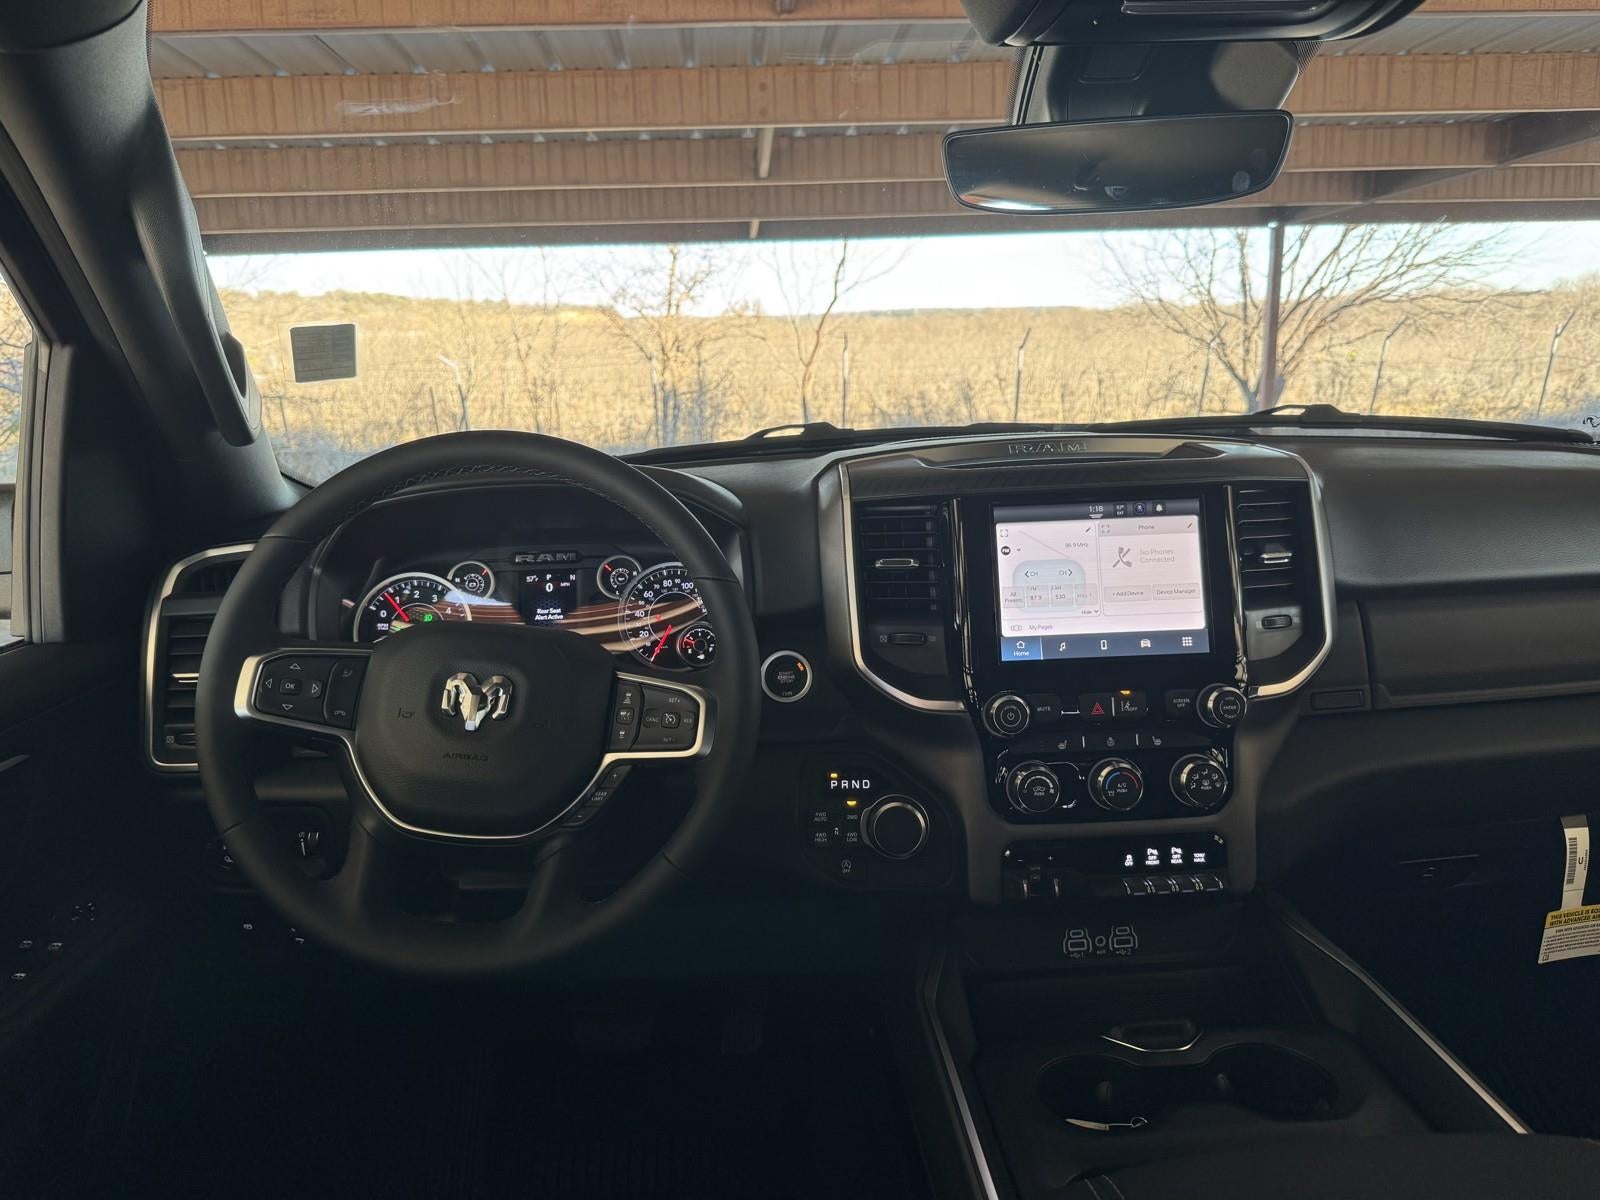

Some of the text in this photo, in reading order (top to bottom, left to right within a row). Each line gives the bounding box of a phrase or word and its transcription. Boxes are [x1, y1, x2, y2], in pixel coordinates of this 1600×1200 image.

[1008, 440, 1088, 455] RAM
[1088, 505, 1104, 513] 1:18
[1140, 547, 1174, 556] No Phones
[515, 552, 577, 562] RAM
[545, 582, 553, 592] 0
[663, 579, 673, 587] 80
[681, 582, 694, 590] 100
[414, 591, 420, 599] 2
[644, 590, 654, 598] 60
[380, 610, 387, 618] 0
[634, 610, 645, 618] 40
[1038, 624, 1053, 632] Pages
[639, 630, 649, 638] 20
[443, 752, 488, 762] AIRBAG
[1563, 909, 1585, 919] VEHICLE
[1563, 915, 1590, 924] ADVANCED
